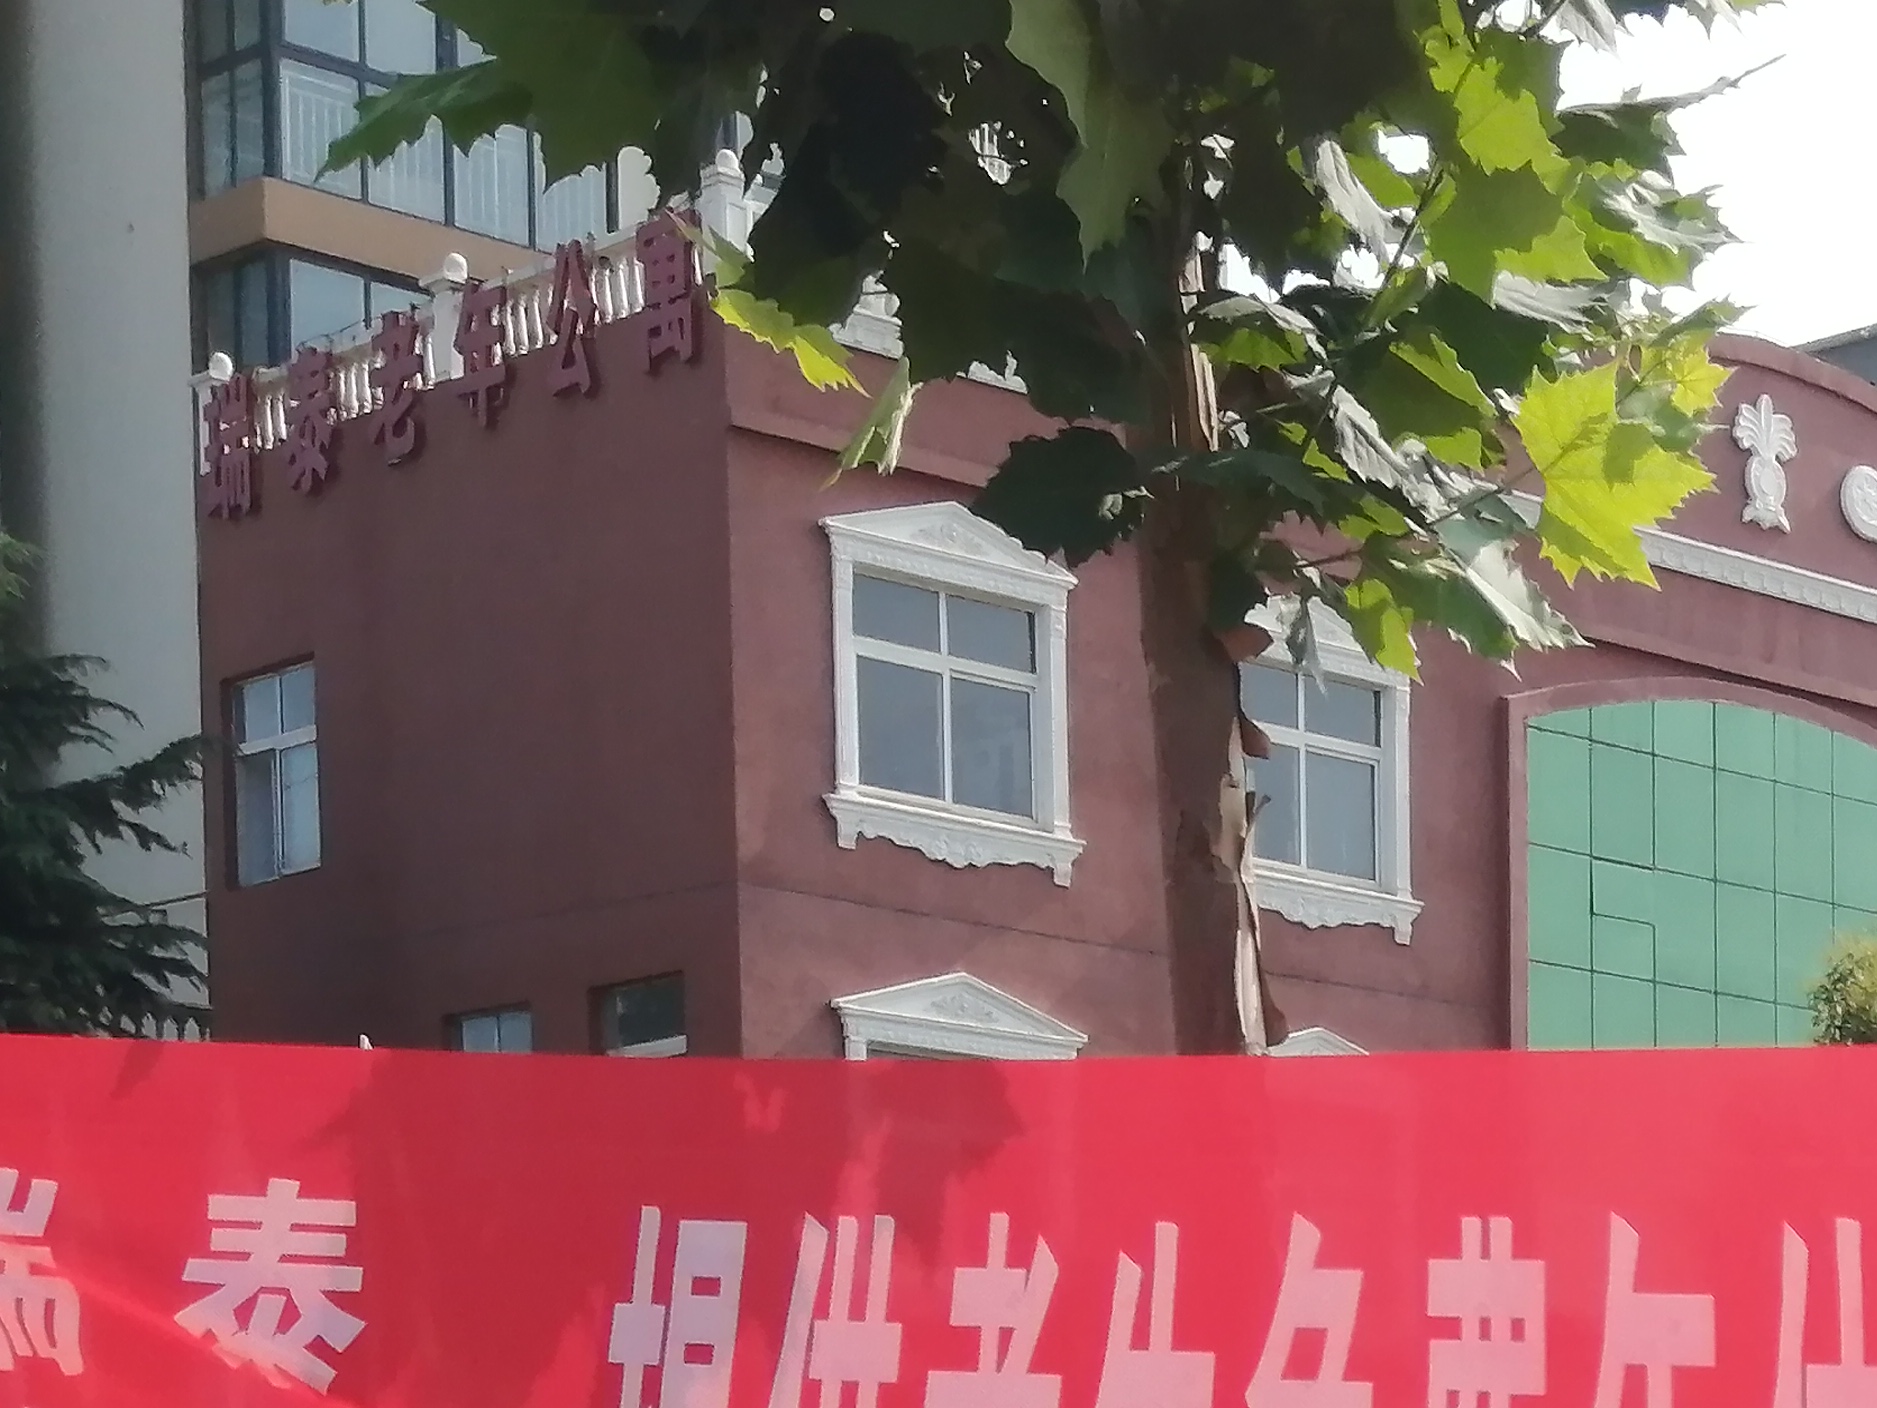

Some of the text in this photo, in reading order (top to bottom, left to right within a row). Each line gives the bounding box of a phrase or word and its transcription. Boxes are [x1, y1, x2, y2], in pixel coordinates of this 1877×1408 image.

[204, 208, 702, 519] 瑞泰老年公寓
